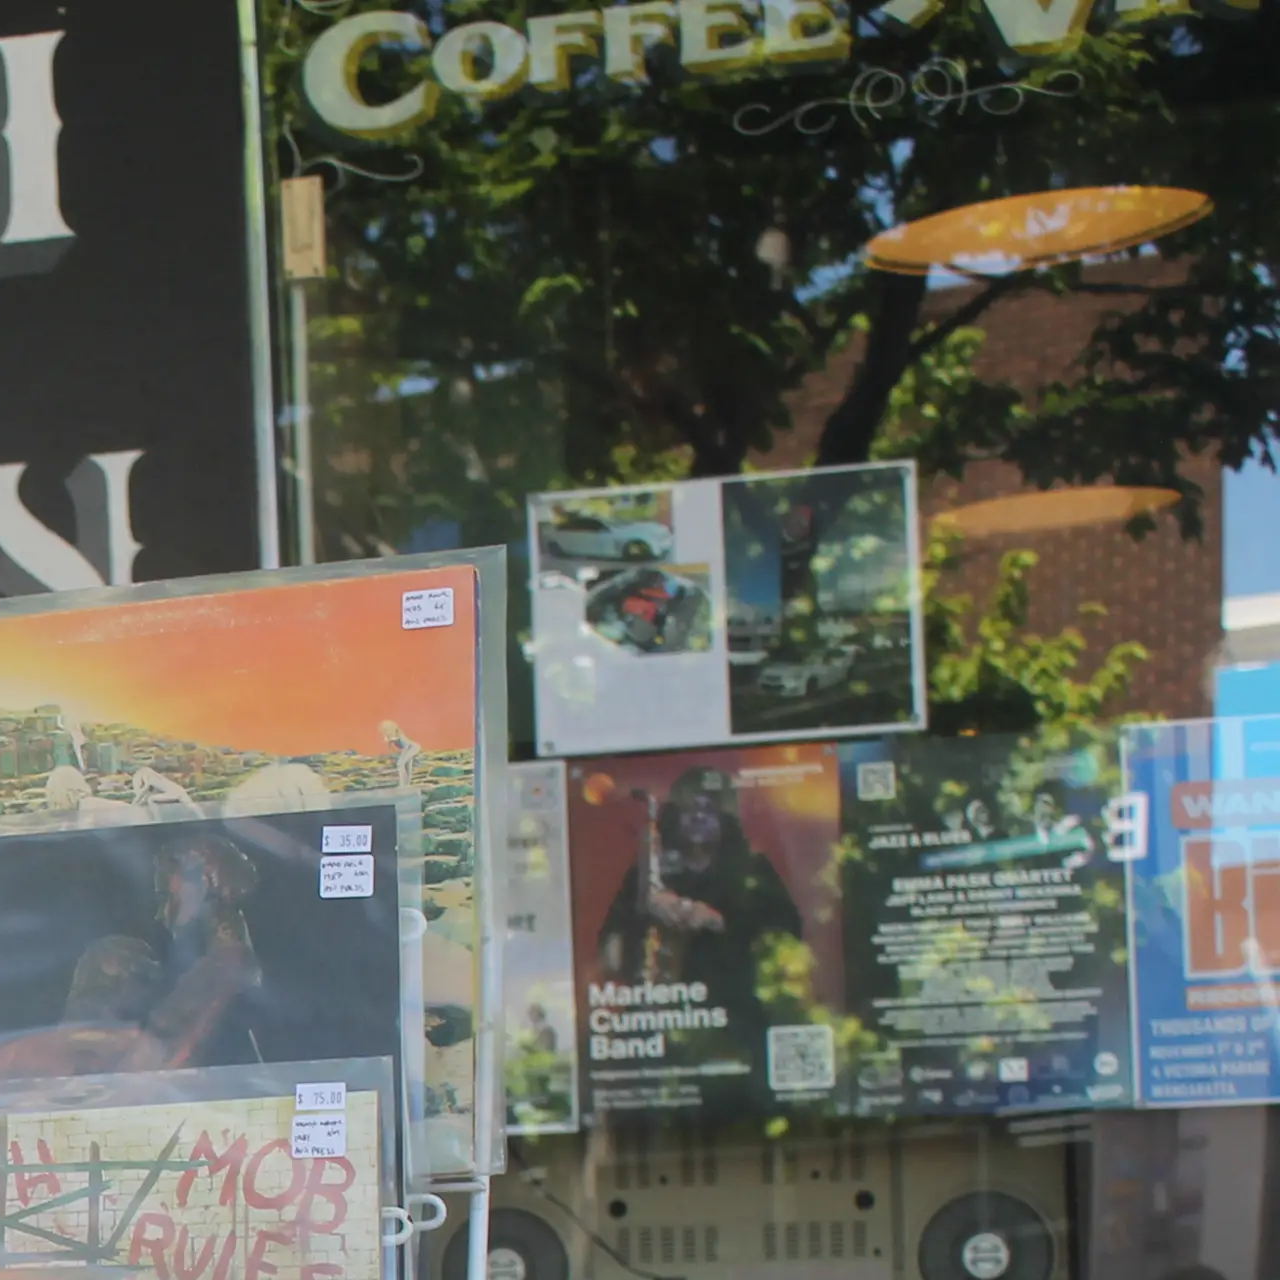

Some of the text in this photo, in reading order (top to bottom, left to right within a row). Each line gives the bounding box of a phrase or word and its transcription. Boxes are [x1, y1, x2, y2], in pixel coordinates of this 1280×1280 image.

[340, 834, 368, 848] 35.00
[588, 979, 708, 1007] Marlene
[590, 1005, 728, 1033] Cummins
[591, 1033, 665, 1060] Band
[313, 1091, 342, 1105] 75.00
[175, 1128, 358, 1236] MOB
